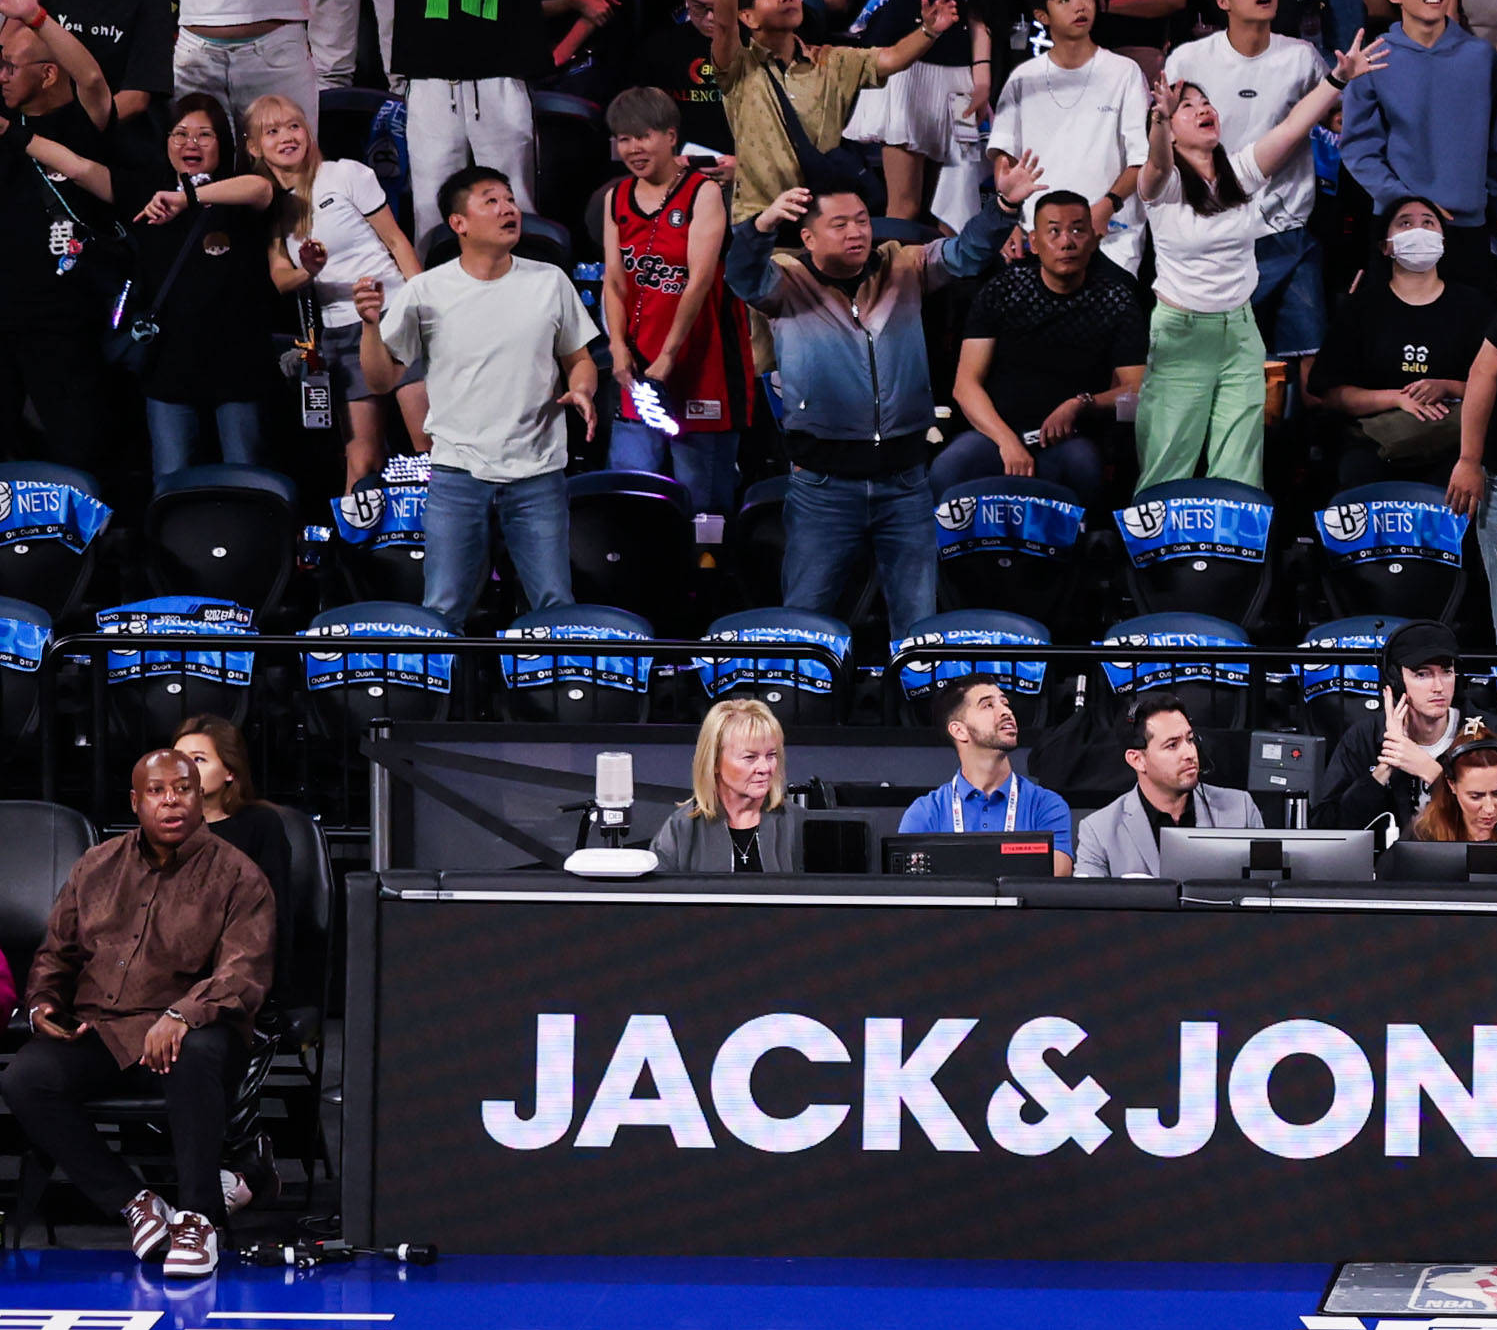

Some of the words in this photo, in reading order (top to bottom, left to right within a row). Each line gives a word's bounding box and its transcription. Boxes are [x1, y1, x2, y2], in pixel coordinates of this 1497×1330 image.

[57, 13, 84, 33] You
[90, 24, 125, 44] only
[16, 491, 60, 514] NETS
[982, 504, 1024, 527] NETS
[1169, 510, 1215, 532] NETS
[1371, 512, 1414, 534] NETS
[1424, 1297, 1475, 1310] NBA
